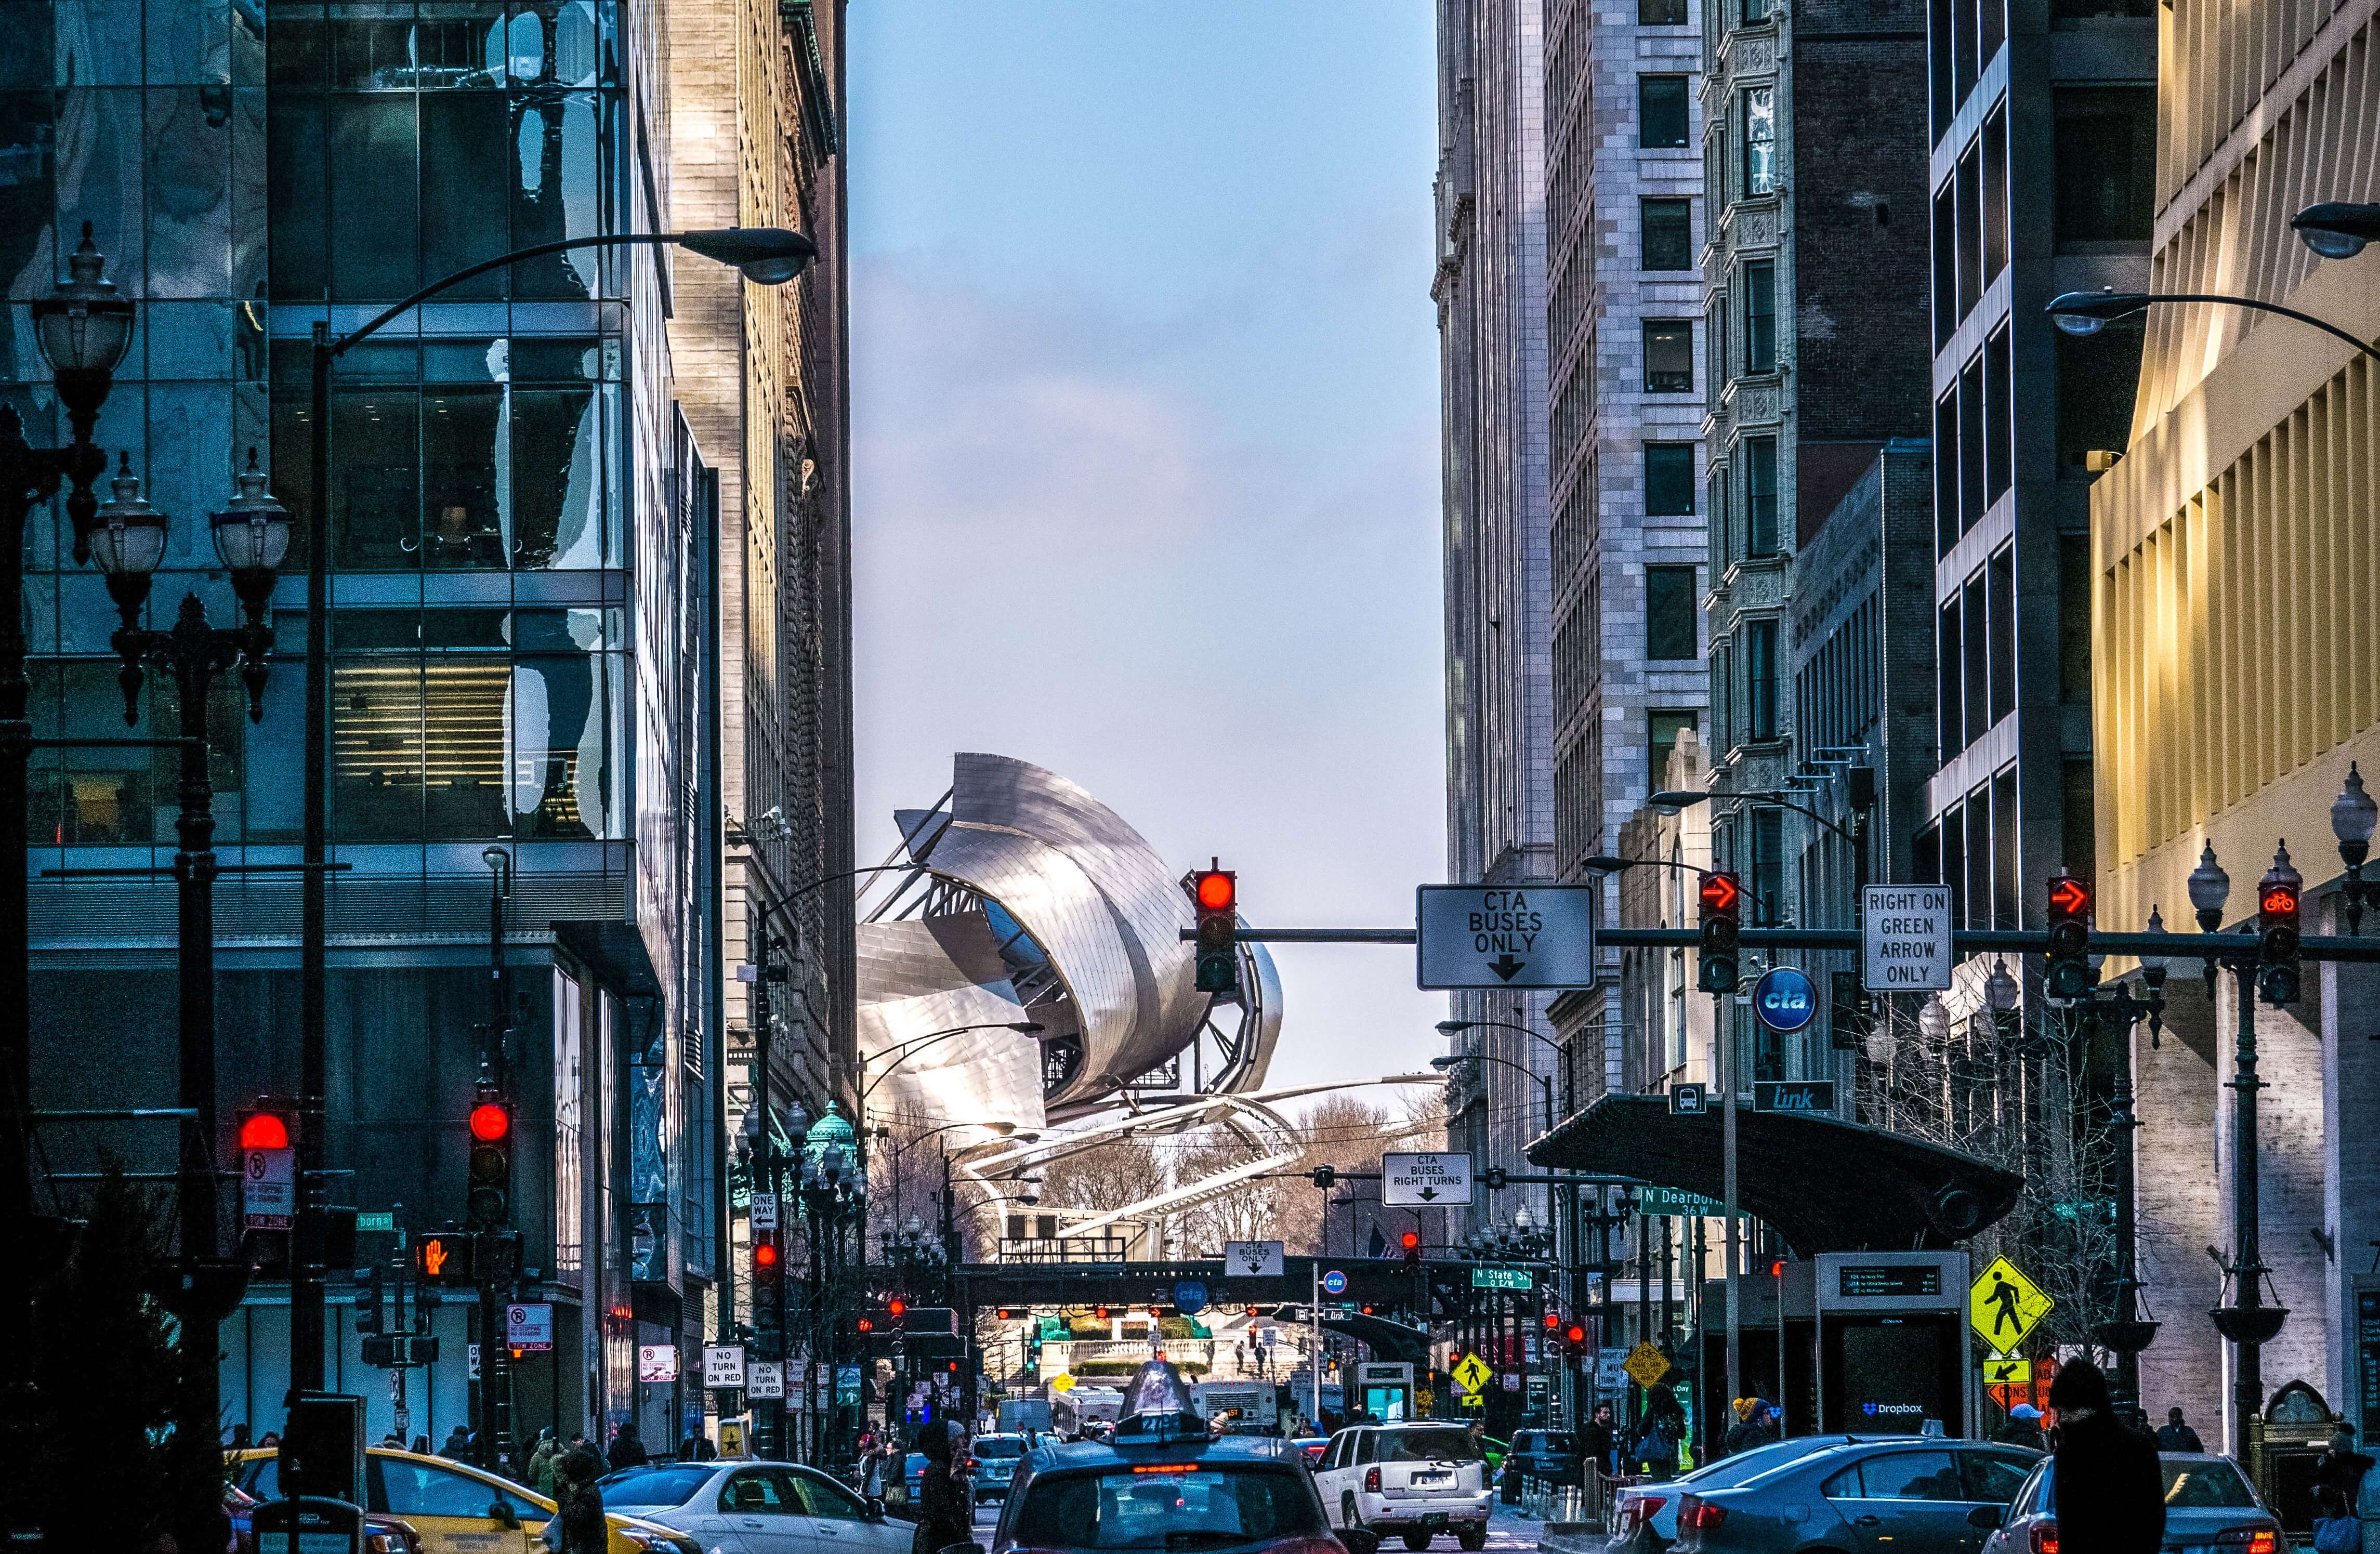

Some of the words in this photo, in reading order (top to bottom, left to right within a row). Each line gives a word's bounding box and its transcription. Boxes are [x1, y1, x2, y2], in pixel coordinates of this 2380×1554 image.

[1484, 891, 1527, 911] CTA
[1870, 894, 1916, 910] RIGHT
[1923, 893, 1945, 910] ON
[1469, 912, 1542, 931] BUSES
[1882, 918, 1933, 934] GREEN
[1475, 933, 1537, 953] ONLY
[1881, 942, 1936, 958] ARROW
[1887, 966, 1929, 982] ONLY
[1765, 990, 1806, 1009] cta
[1773, 1085, 1814, 1109] link
[1418, 1155, 1437, 1164] CTA
[1411, 1166, 1444, 1175] BUSES
[1394, 1177, 1424, 1186] RIGHT
[1428, 1176, 1462, 1185] TURNS
[754, 1196, 774, 1205] ONE
[1646, 1189, 1653, 1203] N
[754, 1206, 774, 1215] WAY
[1682, 1205, 1697, 1215] 36
[1700, 1205, 1708, 1215] W
[357, 1216, 382, 1227] born
[1477, 1269, 1482, 1278] N
[1488, 1270, 1512, 1280] State
[1331, 1311, 1345, 1320] link
[1878, 1403, 1922, 1415] Dropbox
